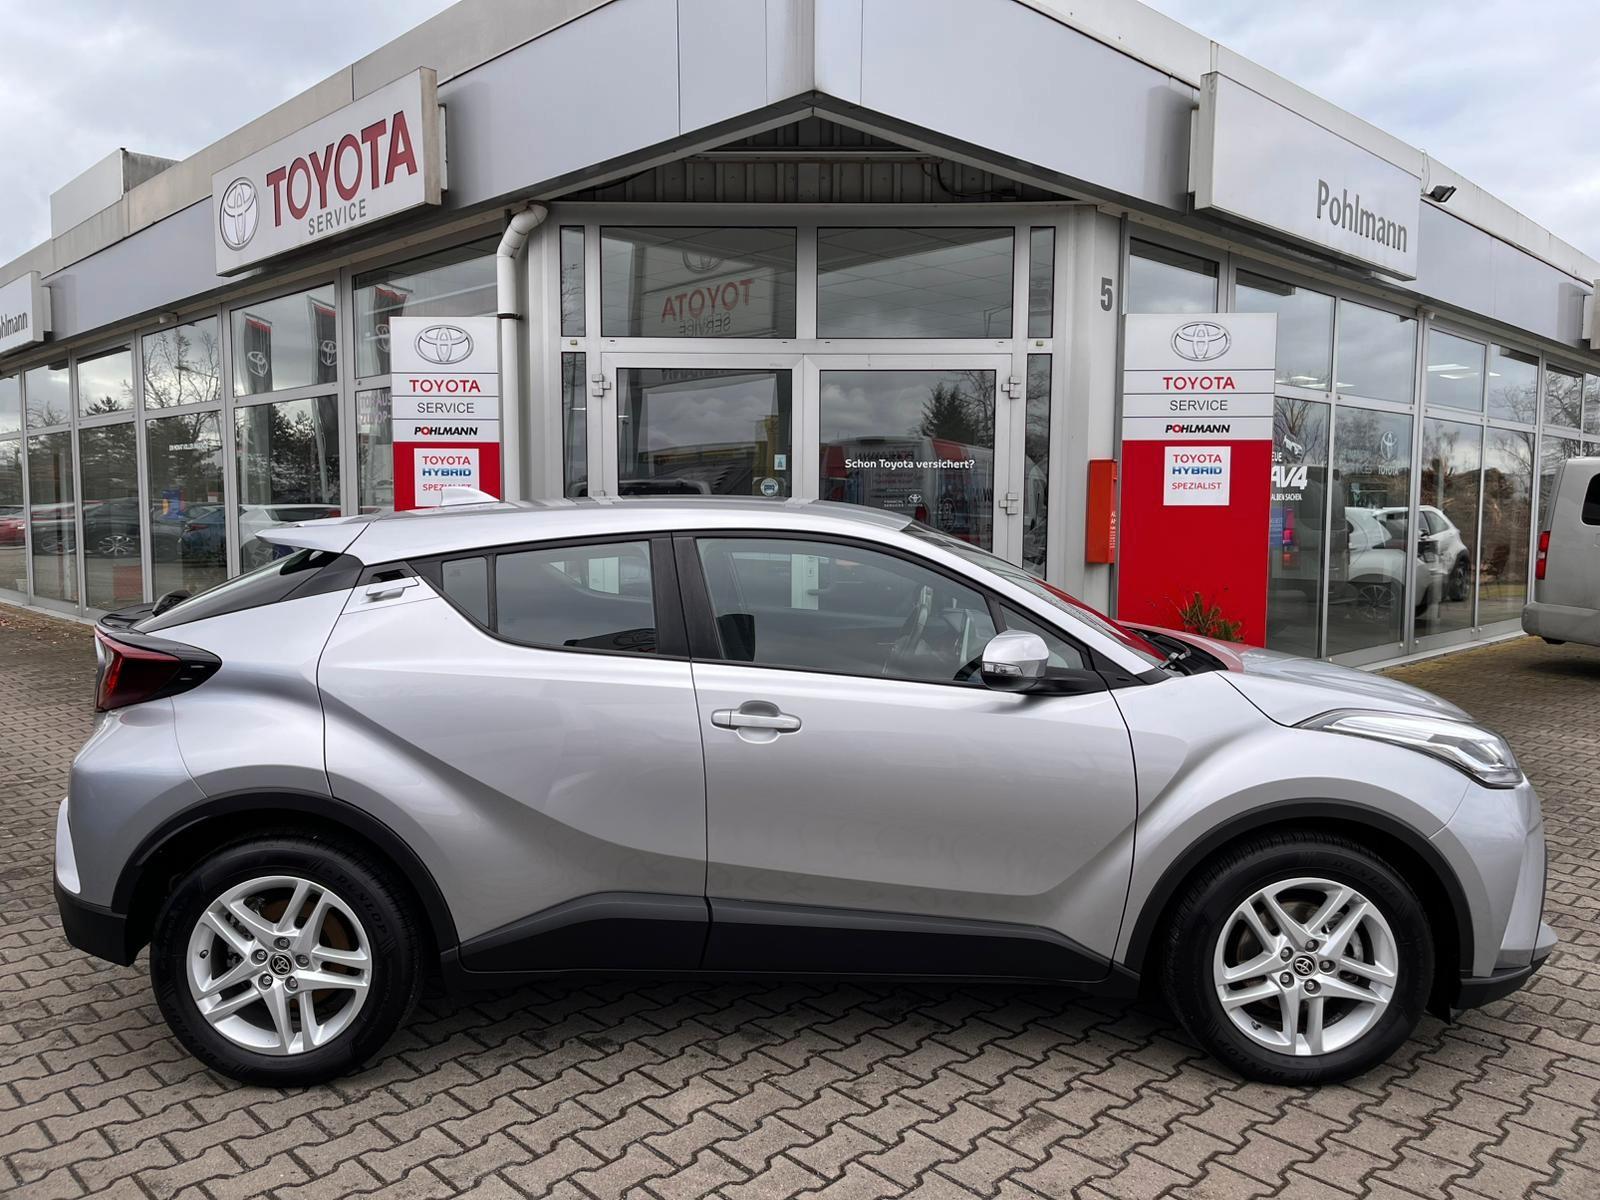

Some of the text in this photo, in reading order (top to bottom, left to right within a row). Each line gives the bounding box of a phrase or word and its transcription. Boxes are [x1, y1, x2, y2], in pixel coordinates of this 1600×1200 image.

[266, 110, 418, 227] TOYOTA
[308, 198, 366, 236] SERVICE
[1317, 179, 1407, 252] Pohlmann
[1100, 277, 1113, 312] 5
[0, 312, 27, 340] hlmann
[410, 380, 481, 392] TOYOTA
[1163, 377, 1234, 390] TOYOTA
[417, 402, 475, 413] SERVICE
[1169, 399, 1228, 411] SERVICE
[414, 427, 478, 436] POHLMANN
[1165, 424, 1230, 433] POHLMANN
[422, 456, 471, 465] TOYOTA
[1172, 453, 1222, 463] TOYOTA
[1271, 452, 1282, 462] EUE
[844, 459, 975, 471] Schon Toyota versichert?
[1172, 466, 1222, 475] HYBRID
[422, 468, 471, 476] HYBRID
[1271, 466, 1308, 490] AV4
[1171, 482, 1223, 491] SPEZIALIST
